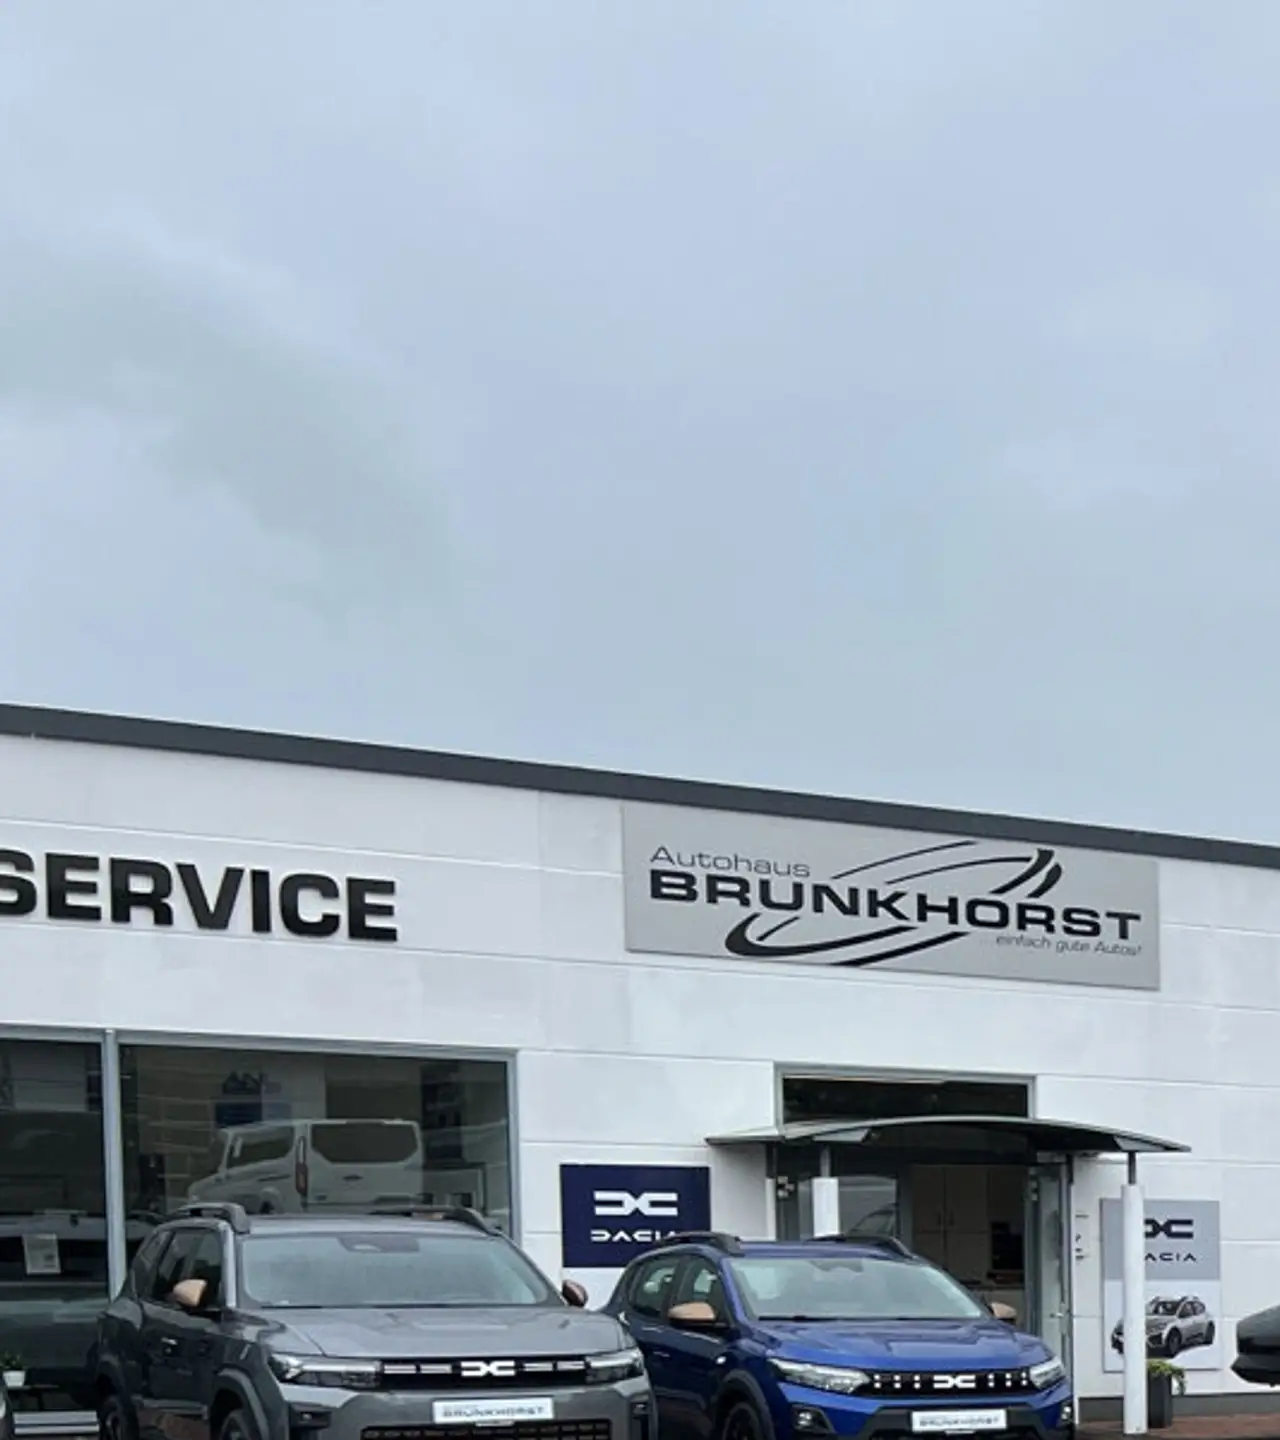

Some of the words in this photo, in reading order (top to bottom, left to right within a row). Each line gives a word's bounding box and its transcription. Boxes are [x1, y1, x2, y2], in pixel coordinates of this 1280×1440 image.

[650, 845, 810, 878] Autohaus
[0, 848, 398, 942] SERVICE
[649, 868, 1142, 941] BRUNKHORST
[1144, 1252, 1197, 1262] ACIA
